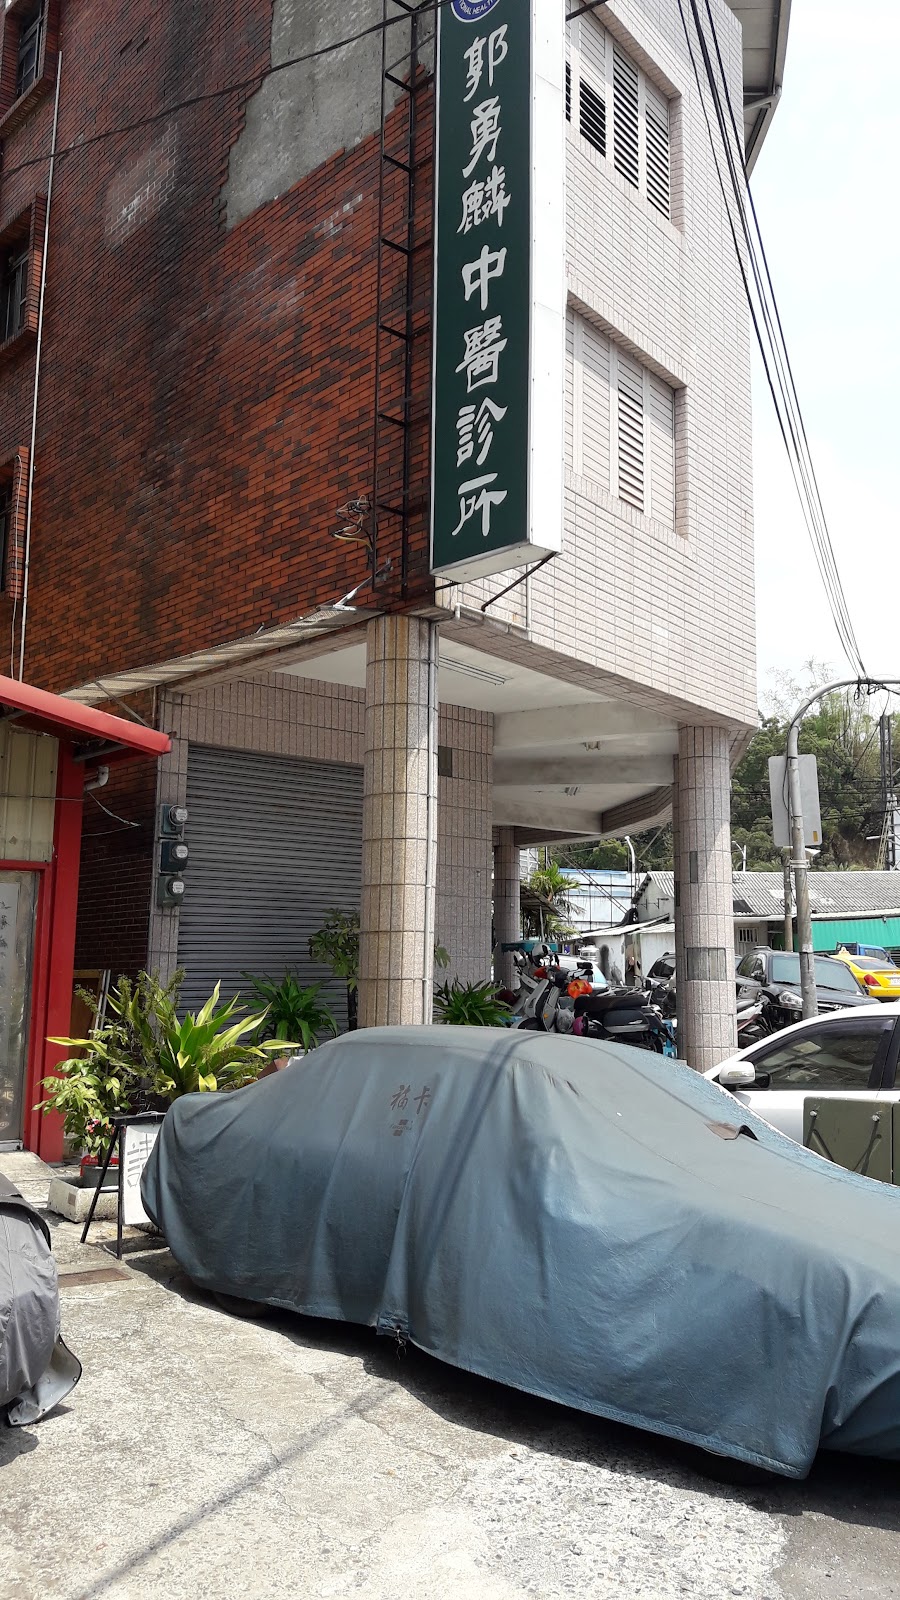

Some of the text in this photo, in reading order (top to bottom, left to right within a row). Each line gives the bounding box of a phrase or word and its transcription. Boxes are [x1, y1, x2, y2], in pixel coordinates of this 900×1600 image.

[452, 24, 511, 536] 郭勇麟中醫診所
